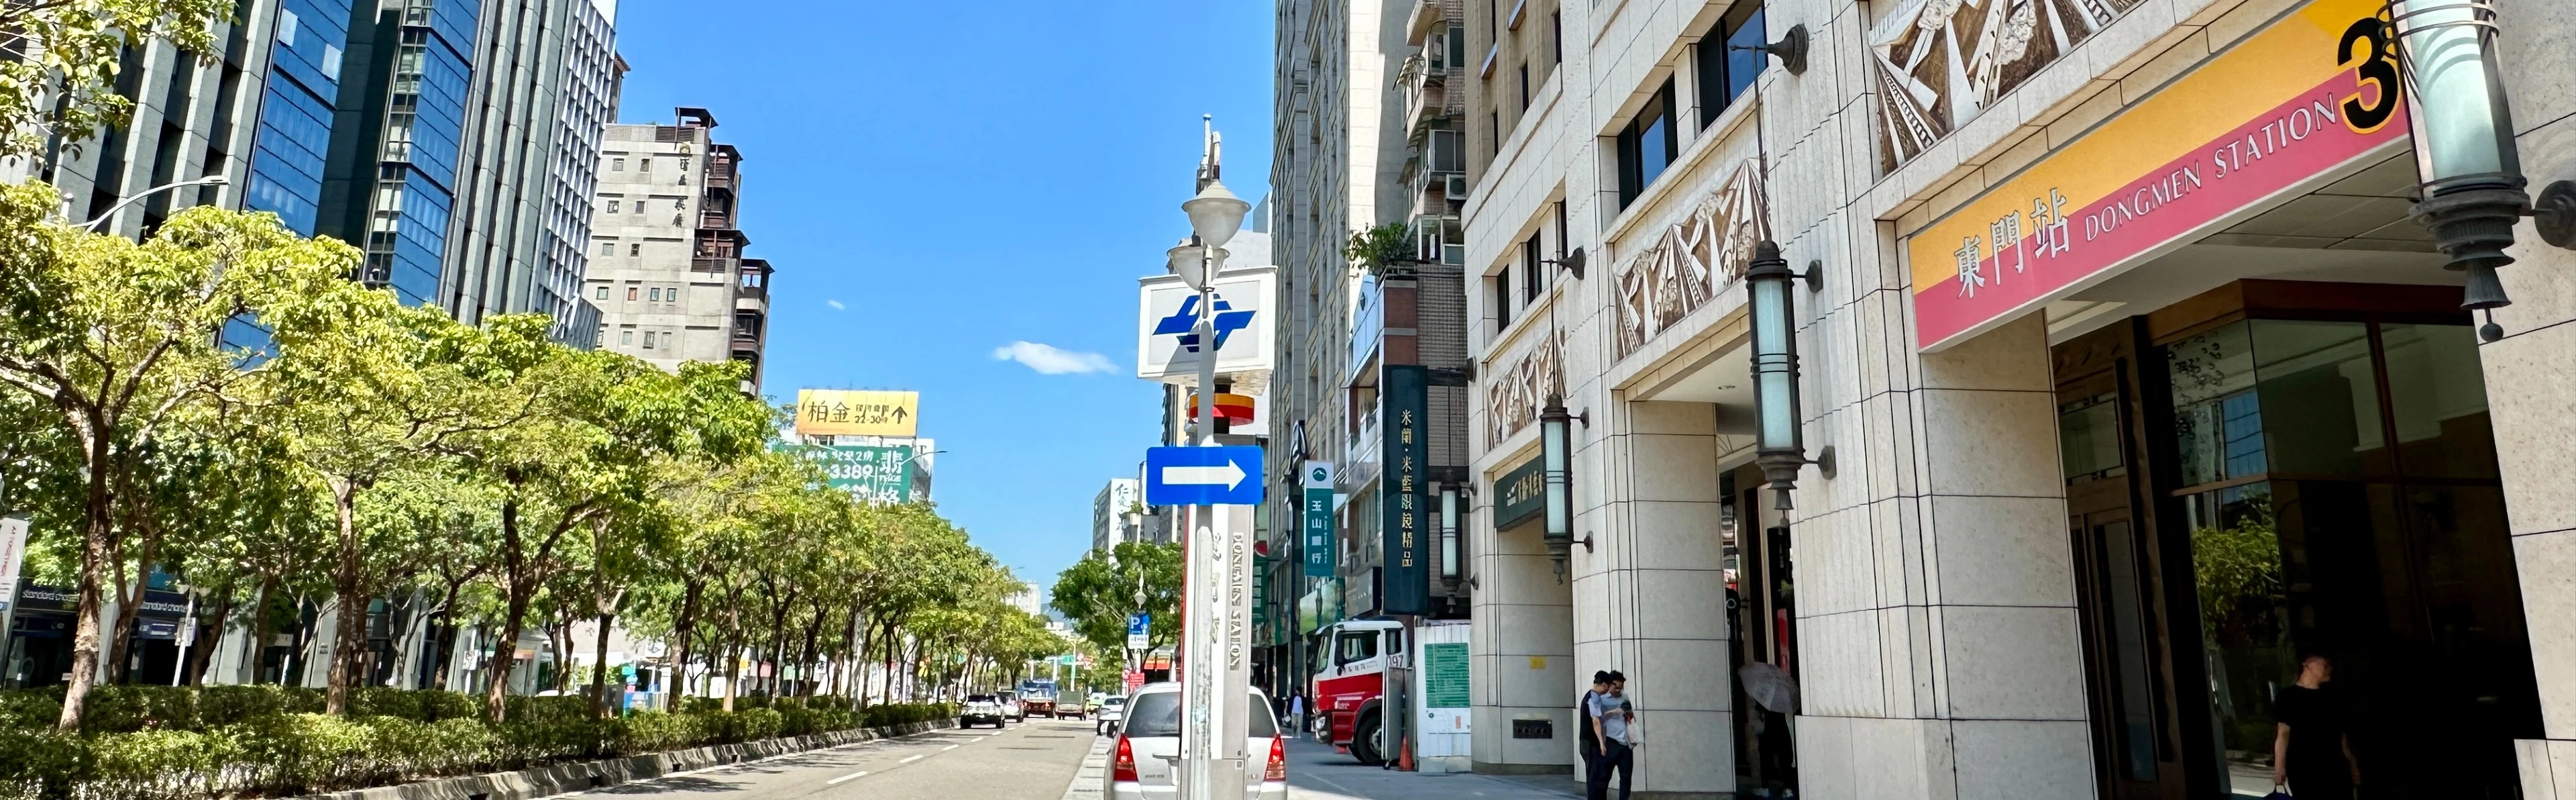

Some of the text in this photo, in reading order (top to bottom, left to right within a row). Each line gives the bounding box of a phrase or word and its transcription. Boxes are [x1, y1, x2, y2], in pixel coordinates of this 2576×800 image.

[2337, 16, 2399, 130] 3
[2085, 92, 2337, 242] DONGMEN STATION
[1953, 187, 2071, 299] 東門站
[808, 400, 850, 423] 柏金
